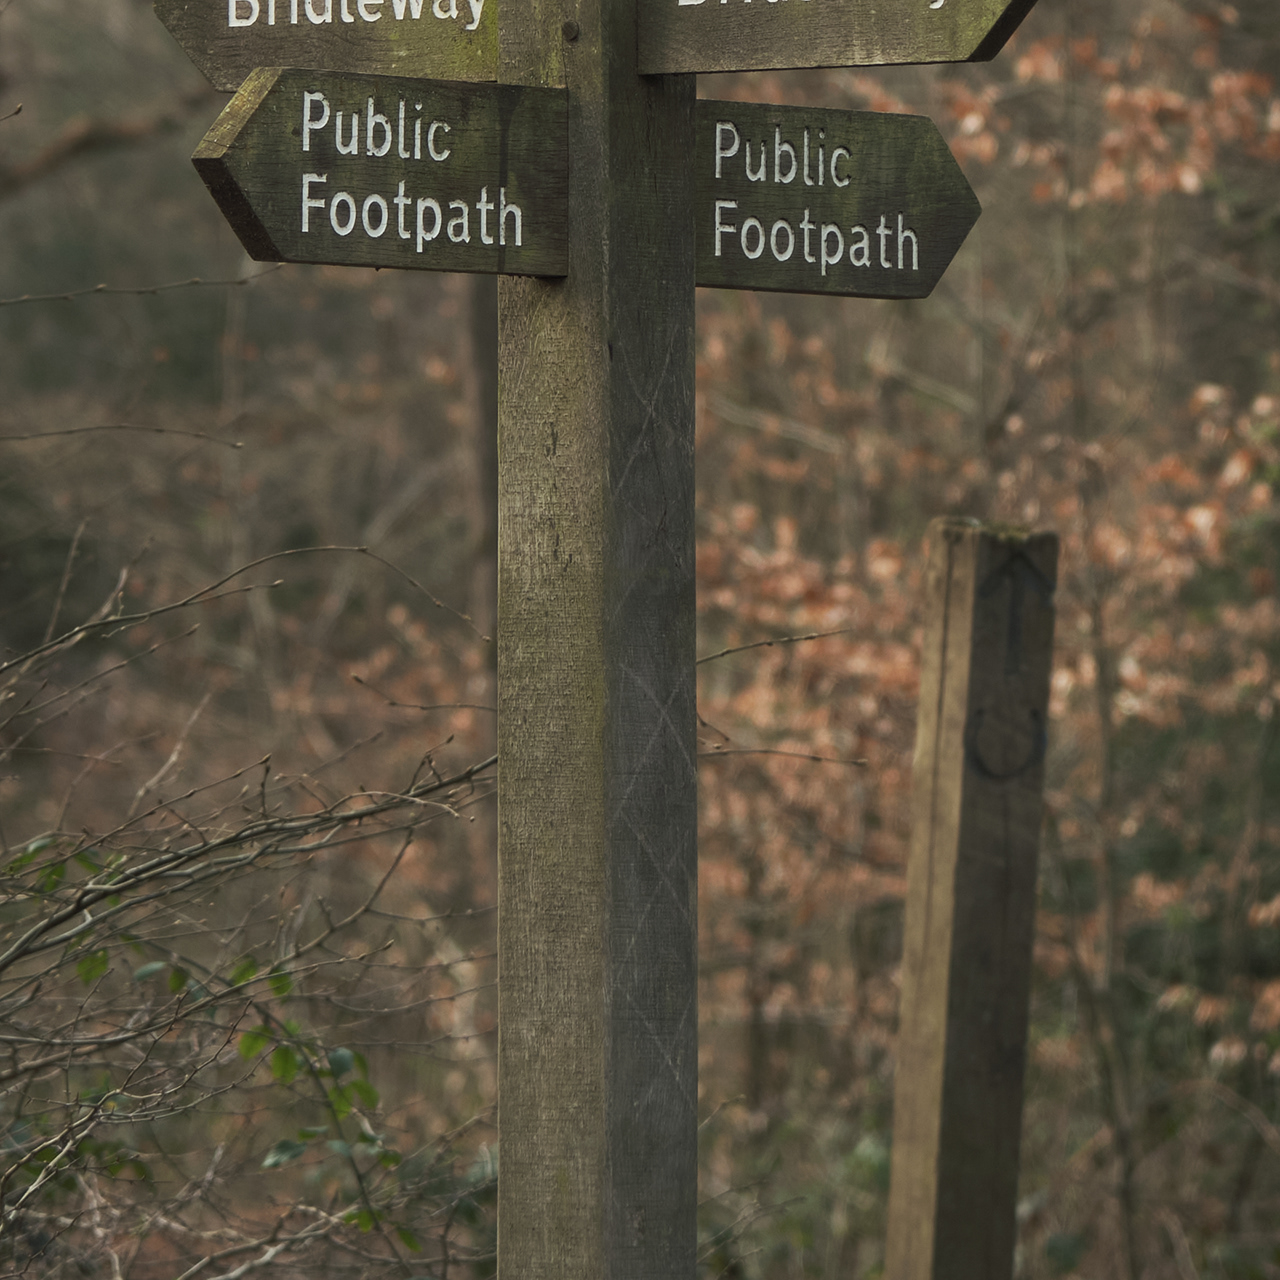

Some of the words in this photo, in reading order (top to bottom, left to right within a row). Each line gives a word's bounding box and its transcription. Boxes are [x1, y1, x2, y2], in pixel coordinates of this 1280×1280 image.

[302, 90, 452, 162] Public
[714, 121, 852, 188] Public
[301, 172, 523, 254] Footpath
[714, 199, 920, 277] Footpath
